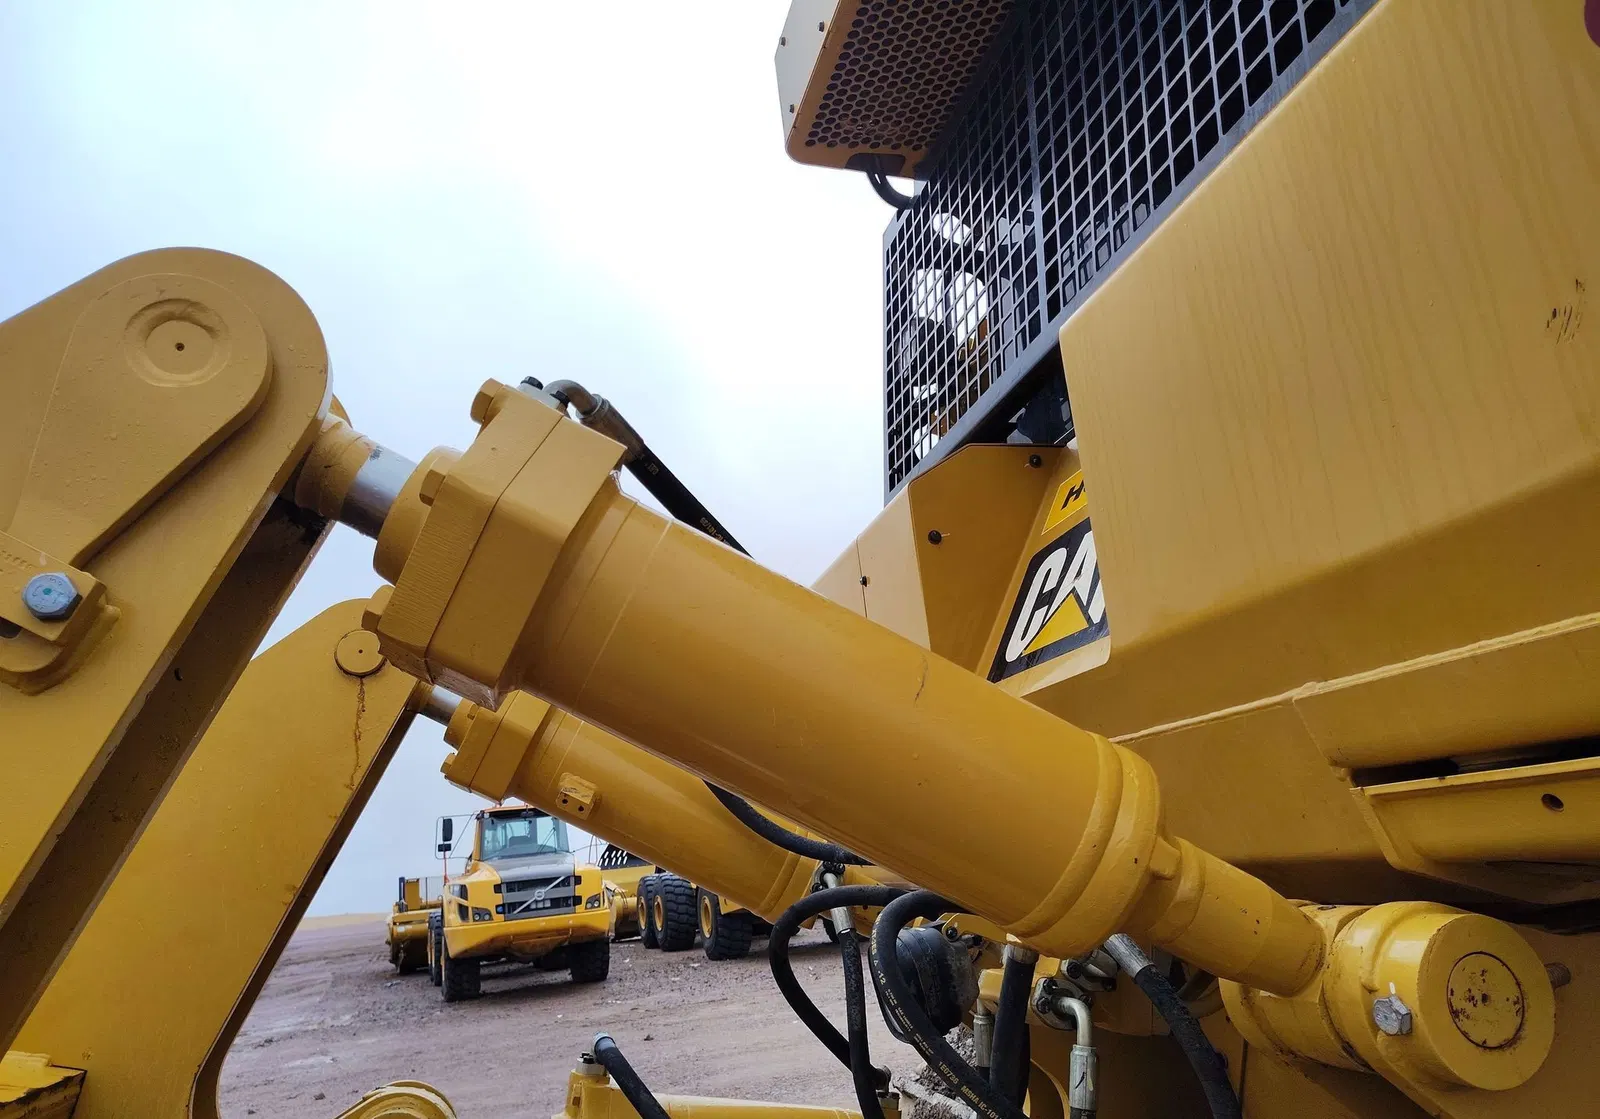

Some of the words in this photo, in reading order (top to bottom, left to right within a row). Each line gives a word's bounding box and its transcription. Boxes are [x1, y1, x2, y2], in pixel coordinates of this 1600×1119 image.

[1061, 479, 1086, 510] H
[961, 1085, 980, 1105] MSHA
[978, 1101, 1002, 1119] IC-101
